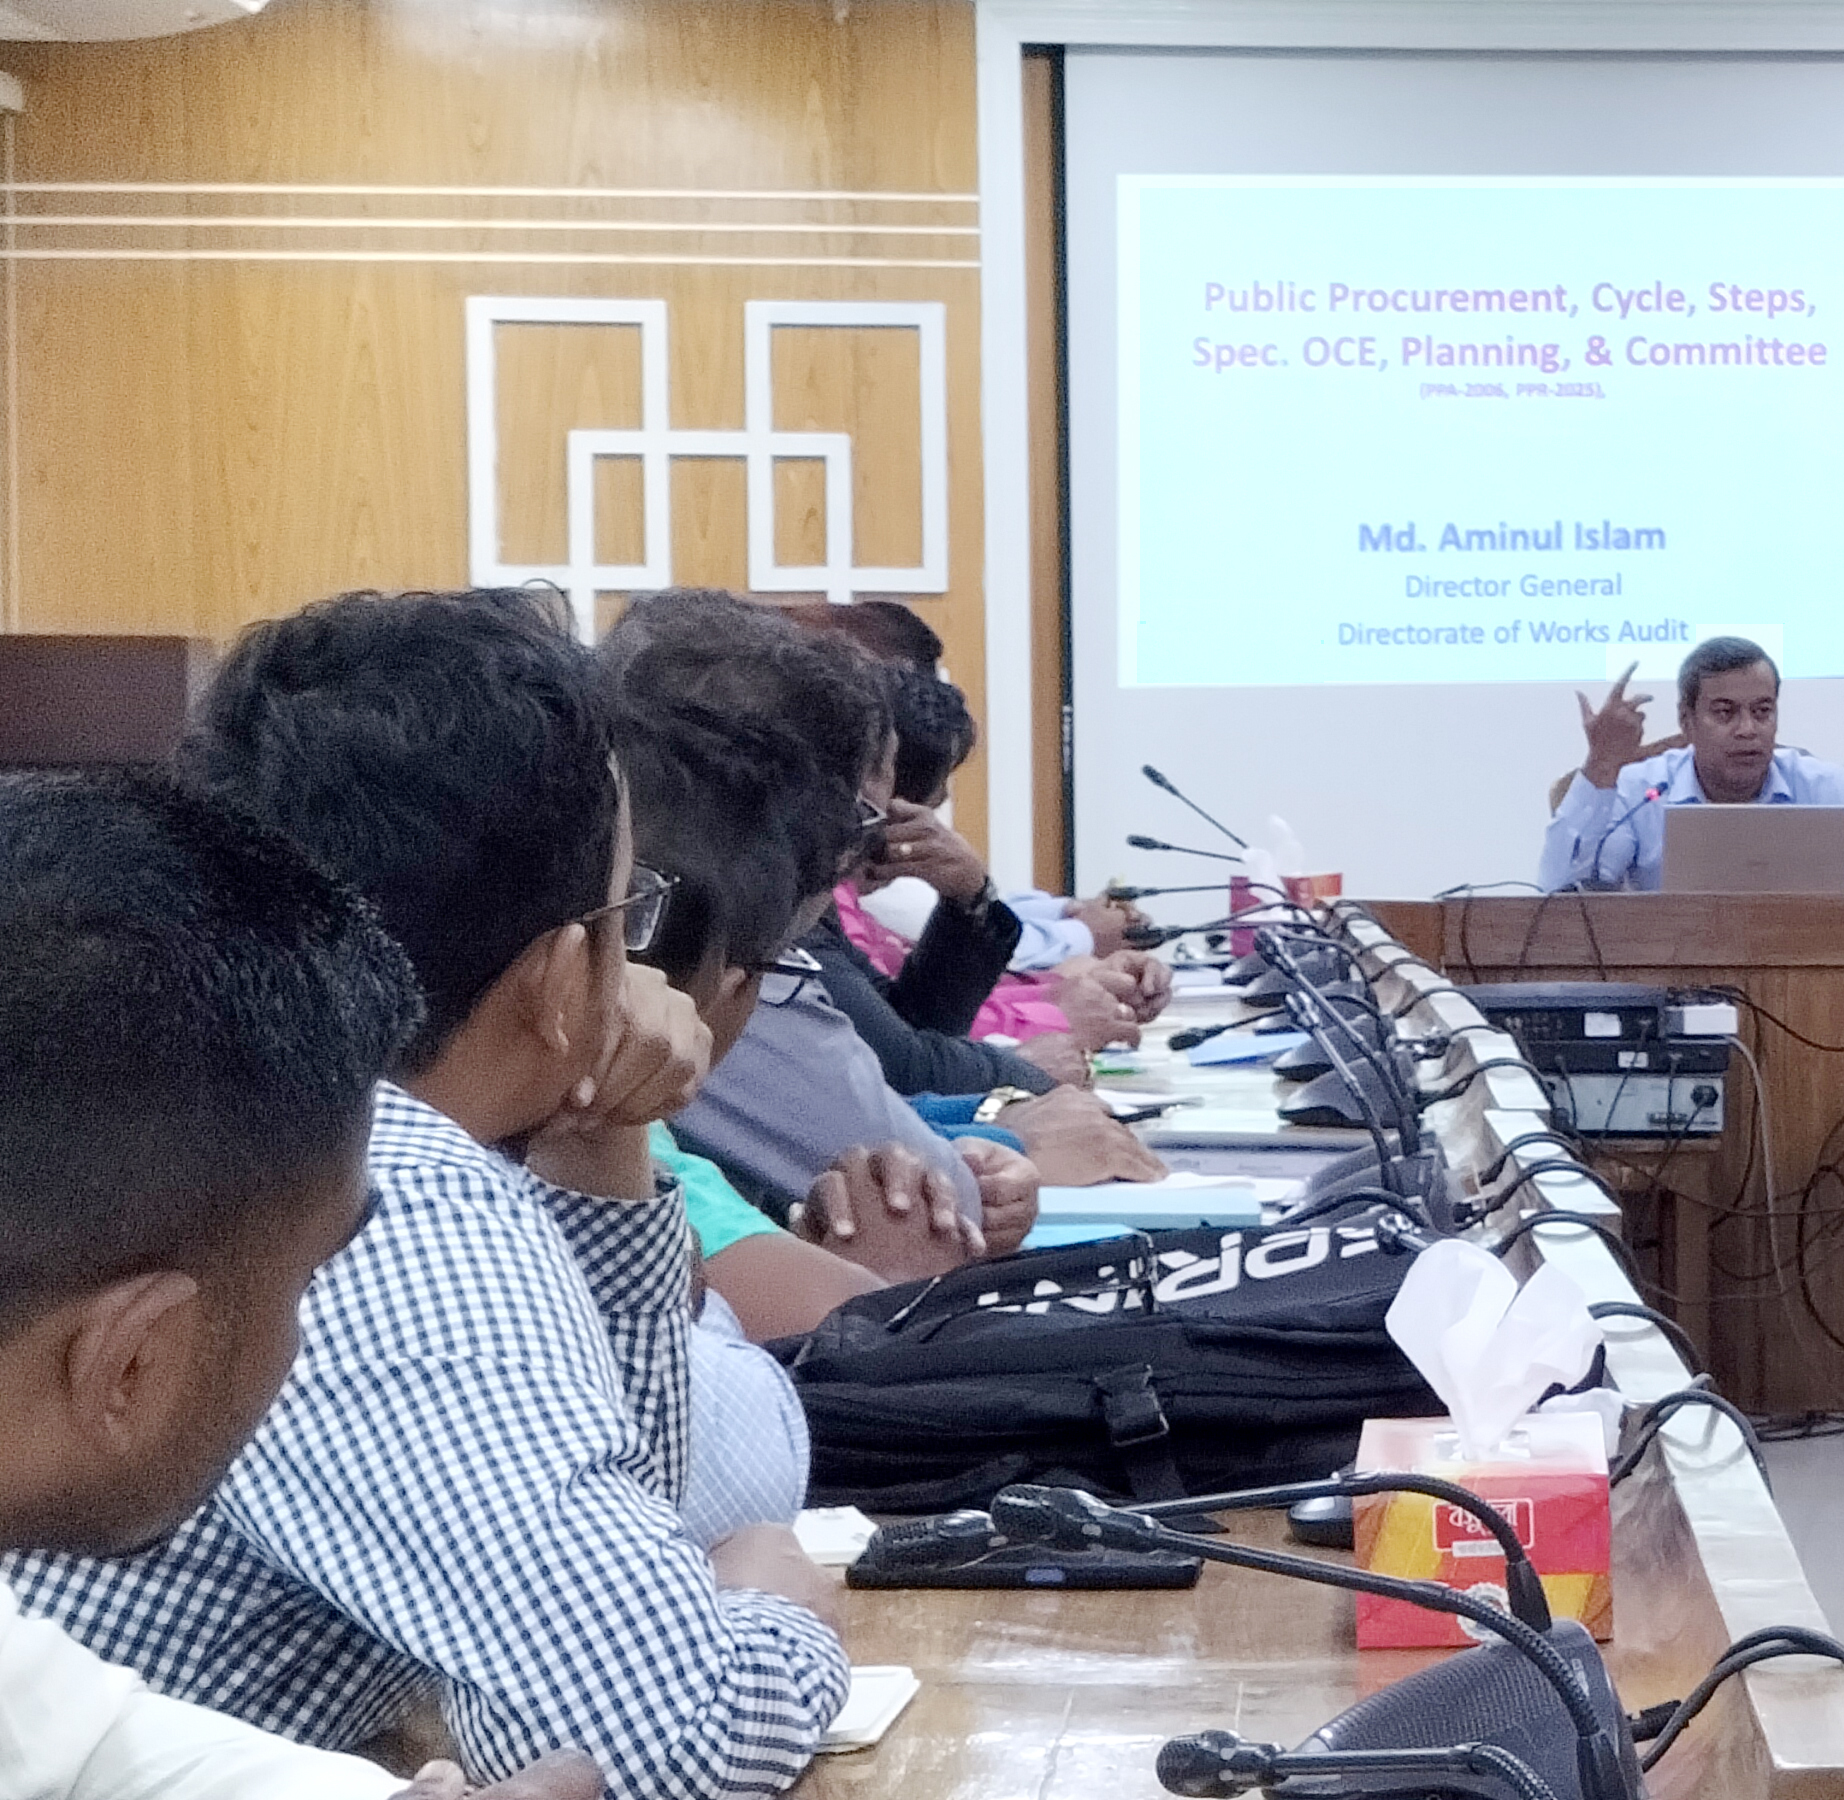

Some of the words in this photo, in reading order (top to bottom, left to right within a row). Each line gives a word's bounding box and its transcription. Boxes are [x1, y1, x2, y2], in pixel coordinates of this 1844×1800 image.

[1204, 281, 1317, 313] Public
[1328, 284, 1580, 319] Procurement,
[1592, 281, 1697, 320] Cycle,
[1708, 282, 1818, 320] Steps,
[1193, 336, 1290, 374] Spec.
[1302, 337, 1390, 372] OCE,
[1401, 335, 1572, 375] Planning,
[1584, 336, 1615, 367] &
[1625, 335, 1829, 368] Committee
[1358, 522, 1428, 553] Md.
[1438, 520, 1564, 553] Aminul
[1574, 520, 1668, 552] Islam
[1405, 575, 1513, 600] Director
[1519, 573, 1623, 598] General
[1338, 621, 1486, 647] Directorate
[1494, 620, 1523, 646] of
[1529, 620, 1612, 645] Works
[1617, 617, 1690, 643] Audit
